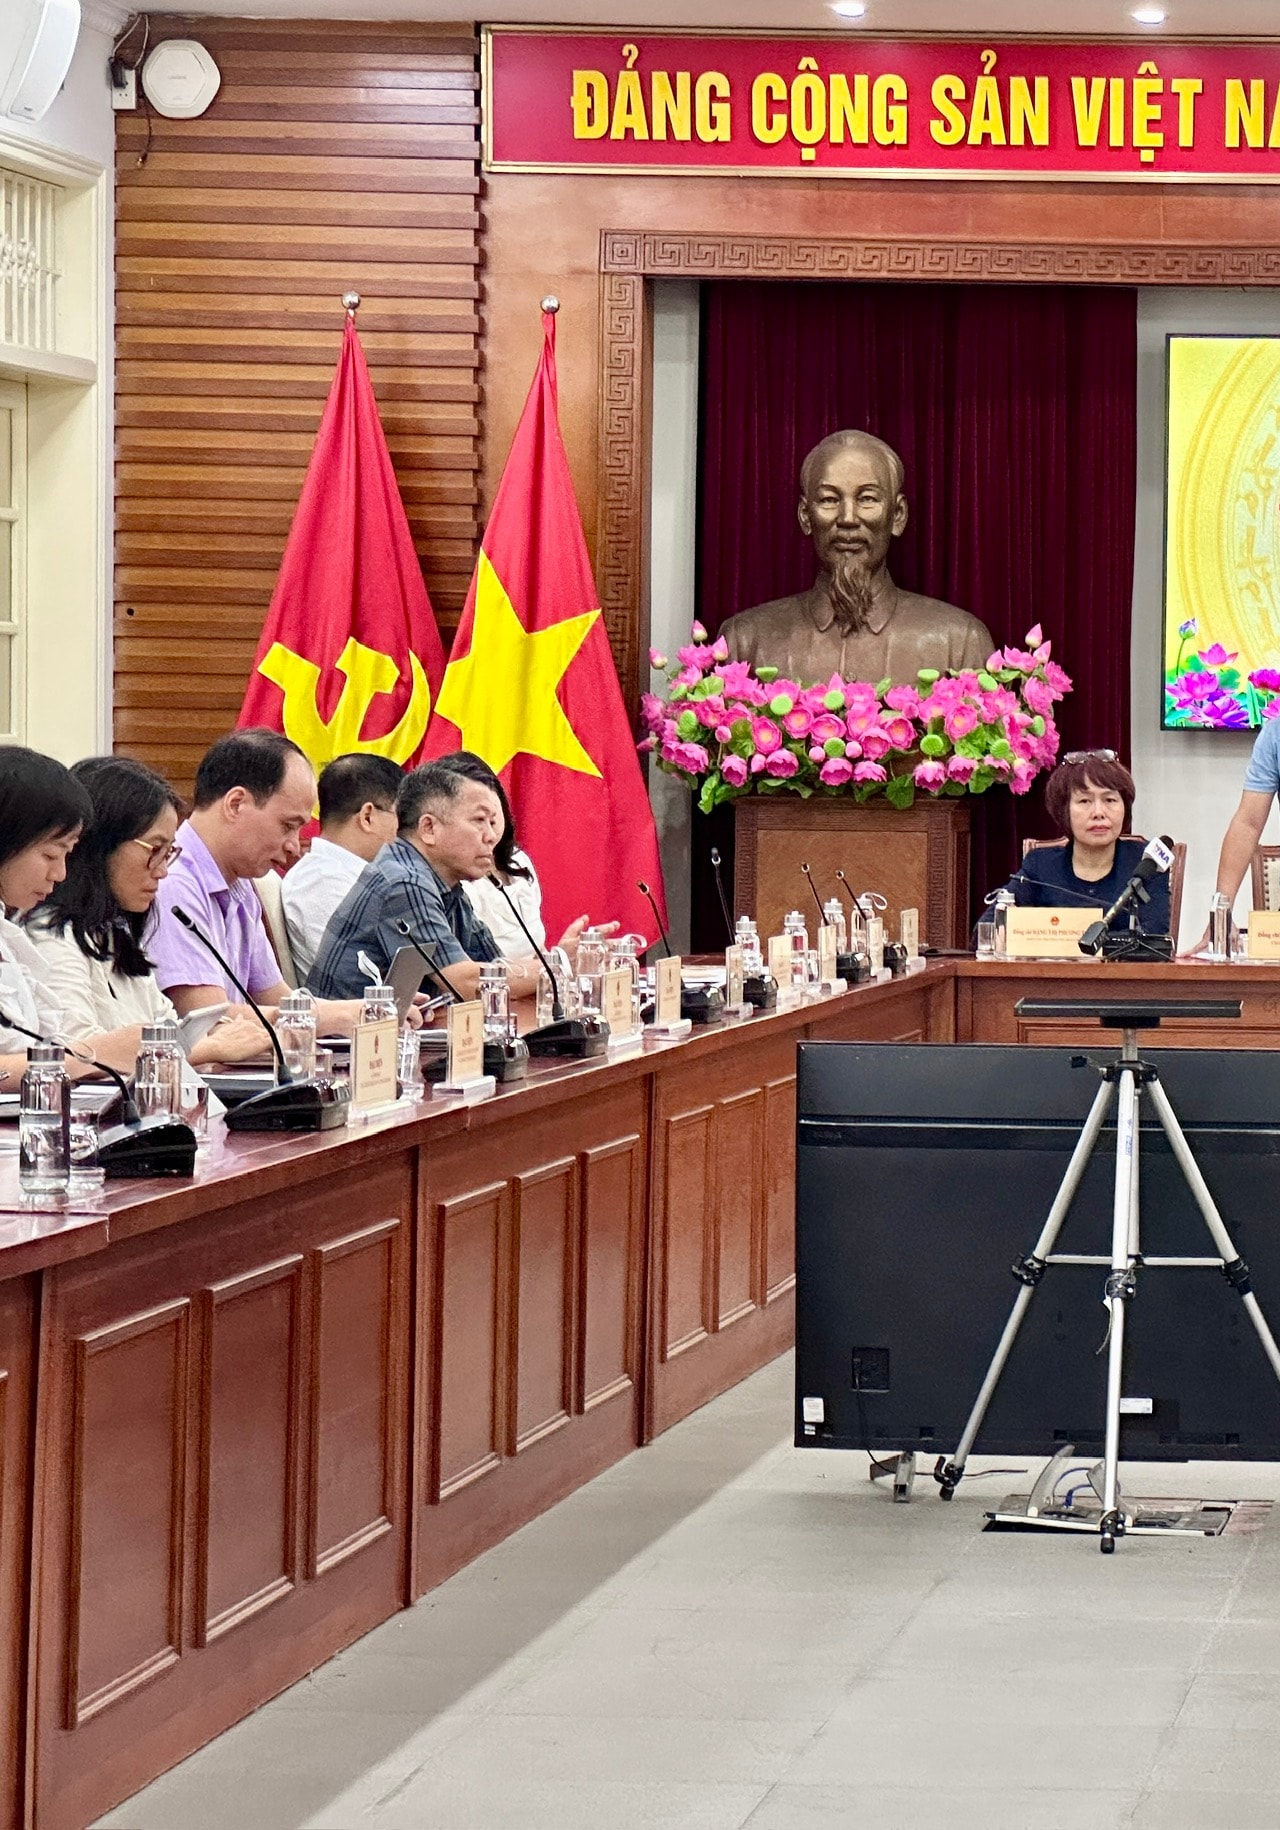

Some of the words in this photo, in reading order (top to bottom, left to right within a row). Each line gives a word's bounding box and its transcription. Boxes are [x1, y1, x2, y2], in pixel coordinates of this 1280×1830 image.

[570, 43, 732, 143] ĐẢNG
[752, 56, 907, 161] CỘNG
[930, 49, 1049, 147] SẢN
[1072, 61, 1203, 162] VIỆT
